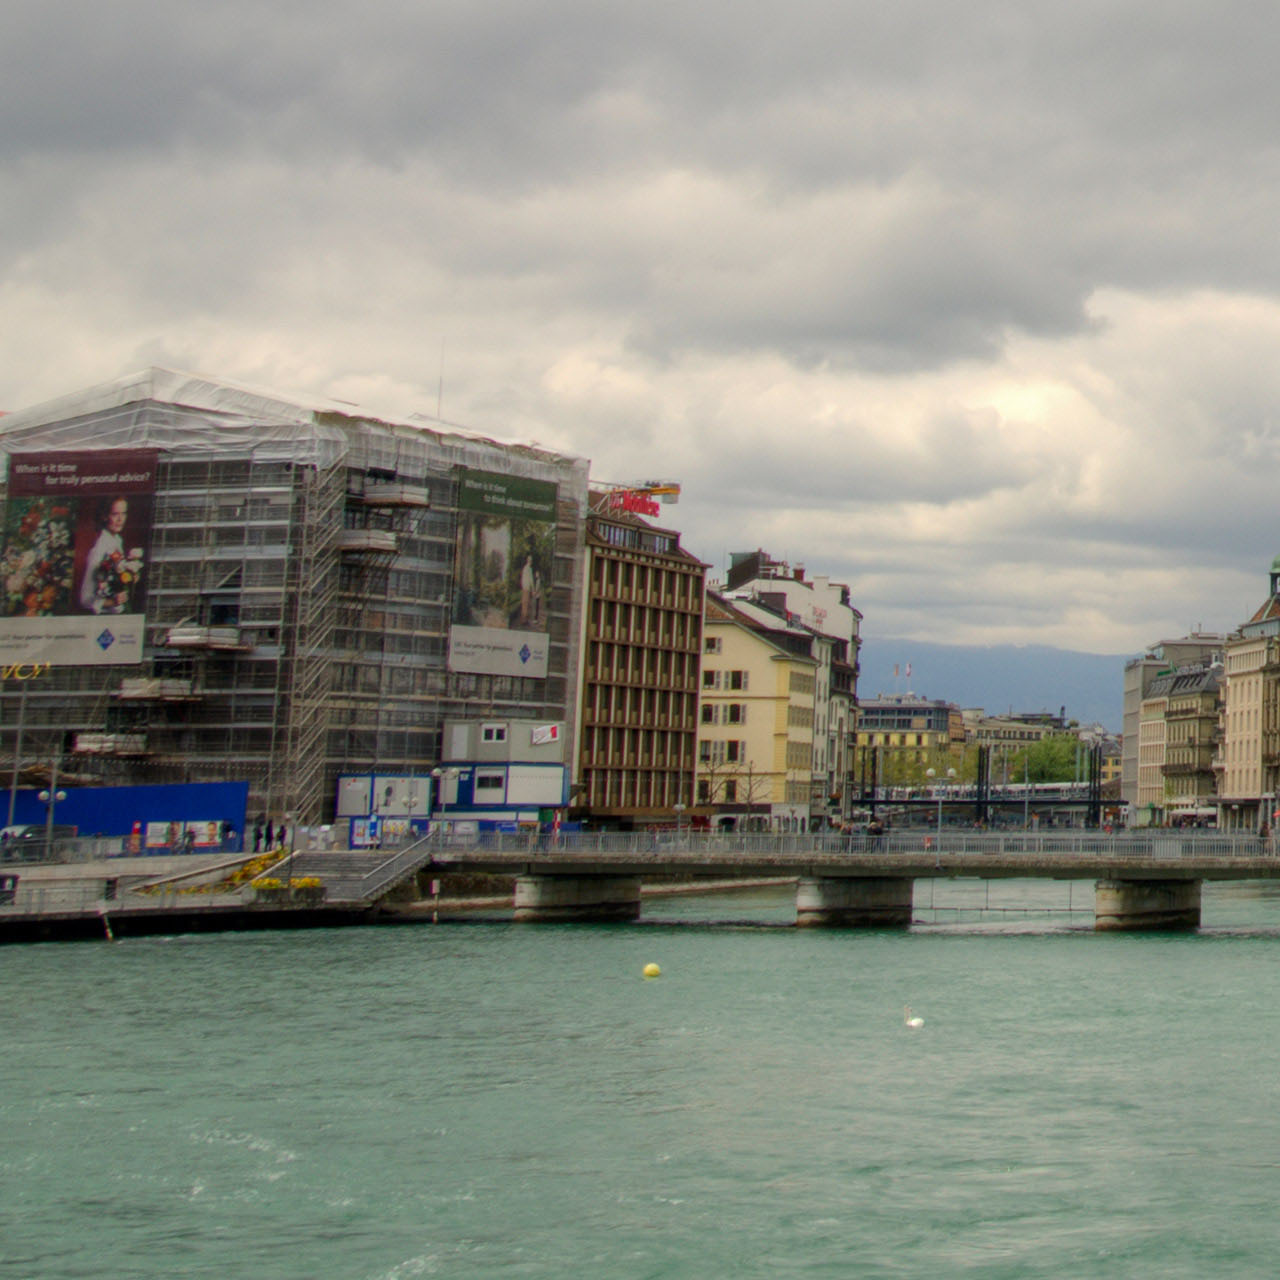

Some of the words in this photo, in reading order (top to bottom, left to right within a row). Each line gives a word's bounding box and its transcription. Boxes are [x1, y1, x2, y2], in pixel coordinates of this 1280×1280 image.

[15, 464, 40, 473] When
[58, 463, 77, 472] time
[45, 475, 58, 485] for
[59, 475, 79, 486] truly
[79, 473, 118, 486] personal
[118, 471, 151, 482] advice?
